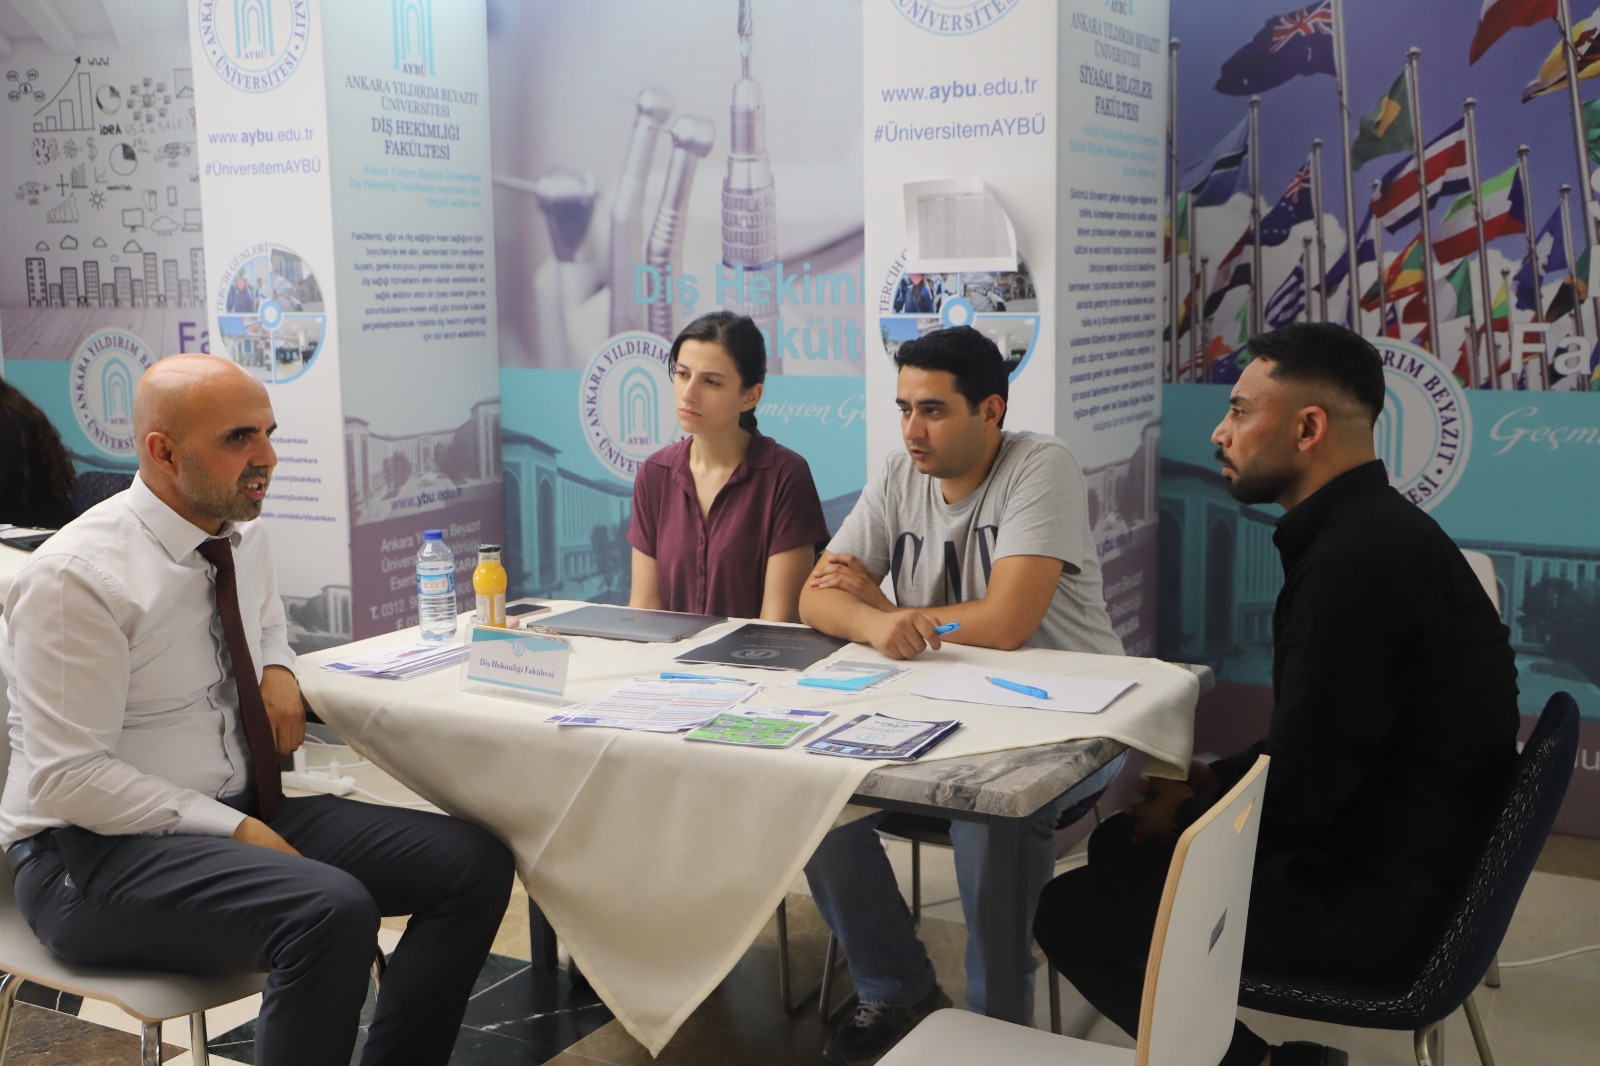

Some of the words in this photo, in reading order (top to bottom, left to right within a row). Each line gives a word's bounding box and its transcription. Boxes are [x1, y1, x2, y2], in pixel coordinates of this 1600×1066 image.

[216, 50, 298, 90] ÜNİVERSİTESİ
[402, 63, 428, 77] AYBÜ
[345, 75, 391, 94] ANKARA
[392, 81, 439, 100] YILDIRIM
[441, 88, 479, 106] BEYAZIT
[881, 77, 1039, 103] www.aybu.edu.tr
[380, 95, 450, 118] ÜNİVERSİTESİ
[208, 127, 314, 146] www.aybu.edu.tr
[371, 116, 393, 136] DİŞ
[396, 119, 460, 141] HEKİMLİĞİ
[874, 112, 1046, 142] #ÜniversitemAYBÜ
[385, 139, 450, 160] FAKÜLTESİ
[205, 155, 321, 176] #ÜniversitemAYBÜ
[633, 263, 699, 317] Diş
[880, 259, 904, 313] TERCİH
[765, 317, 866, 361] kült
[76, 357, 90, 410] ANKARA
[88, 336, 139, 356] YILDIRIM
[586, 365, 606, 427] ANKARA
[604, 341, 670, 365] YILDIRIM
[1423, 375, 1460, 466] BEYAZIT
[1491, 405, 1600, 456] Geçm
[391, 487, 463, 511] www.ybu.edu.tr
[381, 535, 415, 553] Ankara
[450, 520, 481, 538] Beyazıt
[480, 657, 491, 668] Diş
[492, 660, 524, 674] Hekimliği
[525, 665, 555, 679] Fakültesi
